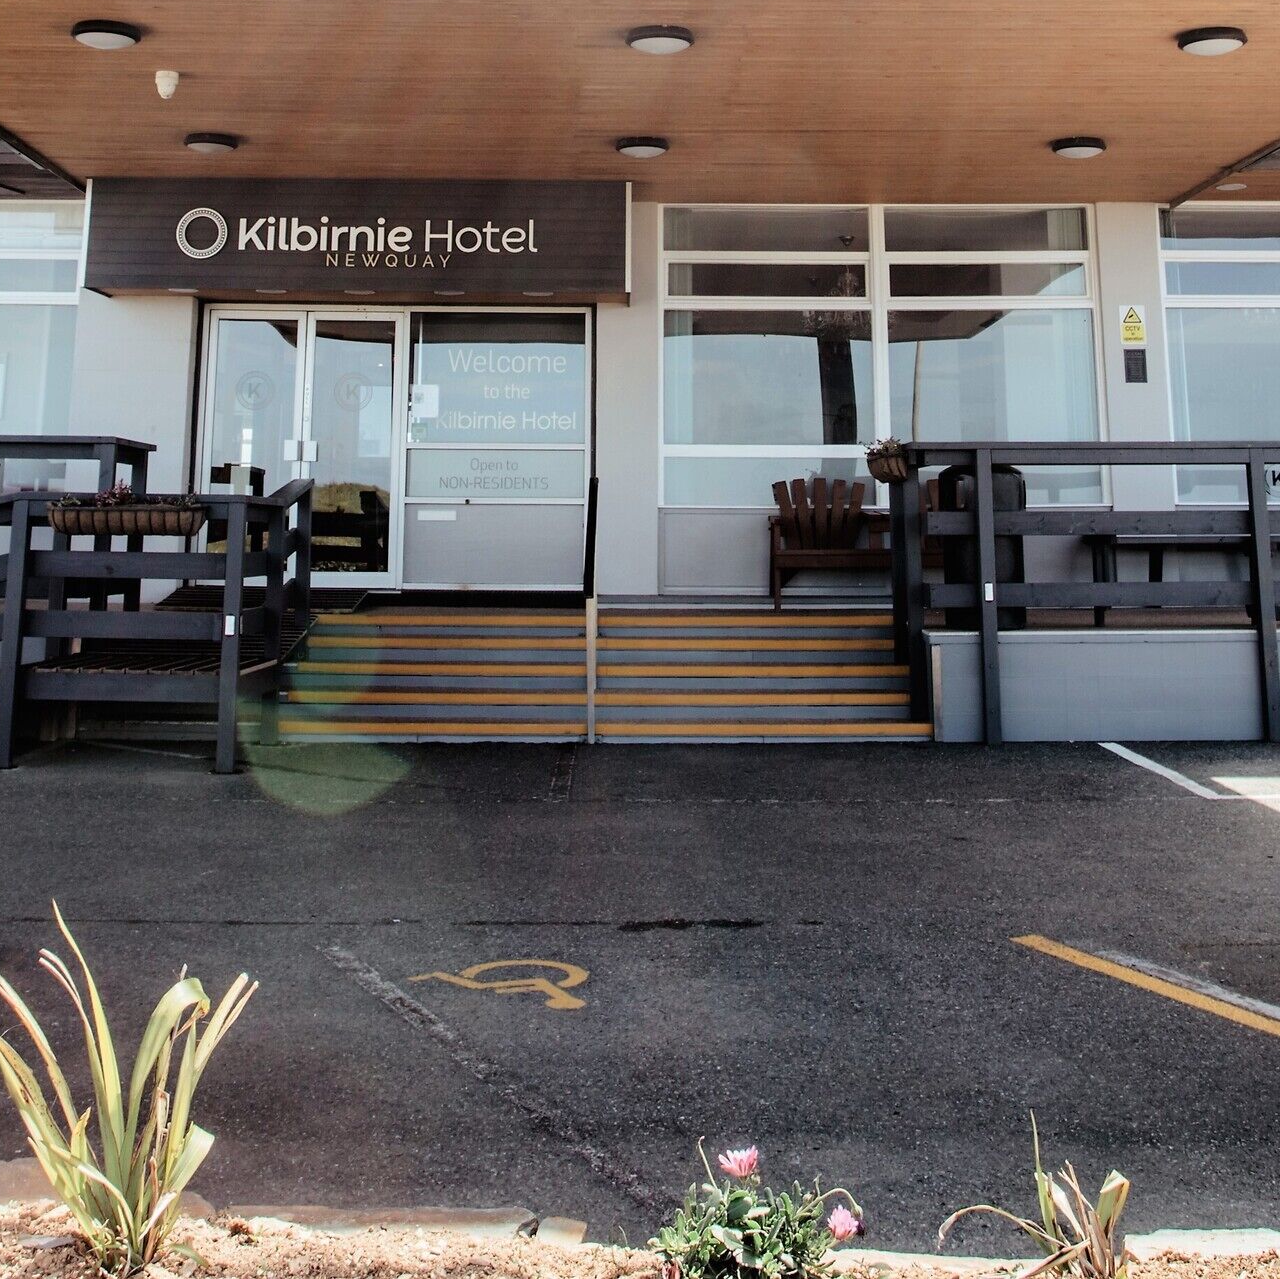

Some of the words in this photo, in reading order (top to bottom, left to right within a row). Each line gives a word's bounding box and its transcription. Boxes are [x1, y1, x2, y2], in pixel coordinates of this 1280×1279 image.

[237, 216, 413, 252] Kilbirnie
[424, 219, 538, 253] Hotel
[325, 253, 452, 268] NEWQUAY
[448, 349, 567, 373] Welcome
[484, 384, 500, 399] to
[504, 384, 531, 399] the
[435, 410, 517, 430] Kilbirnie
[522, 411, 577, 430] Hotel
[470, 458, 503, 474] Open
[505, 459, 519, 471] to
[438, 476, 549, 490] NON-RESIDENTS
